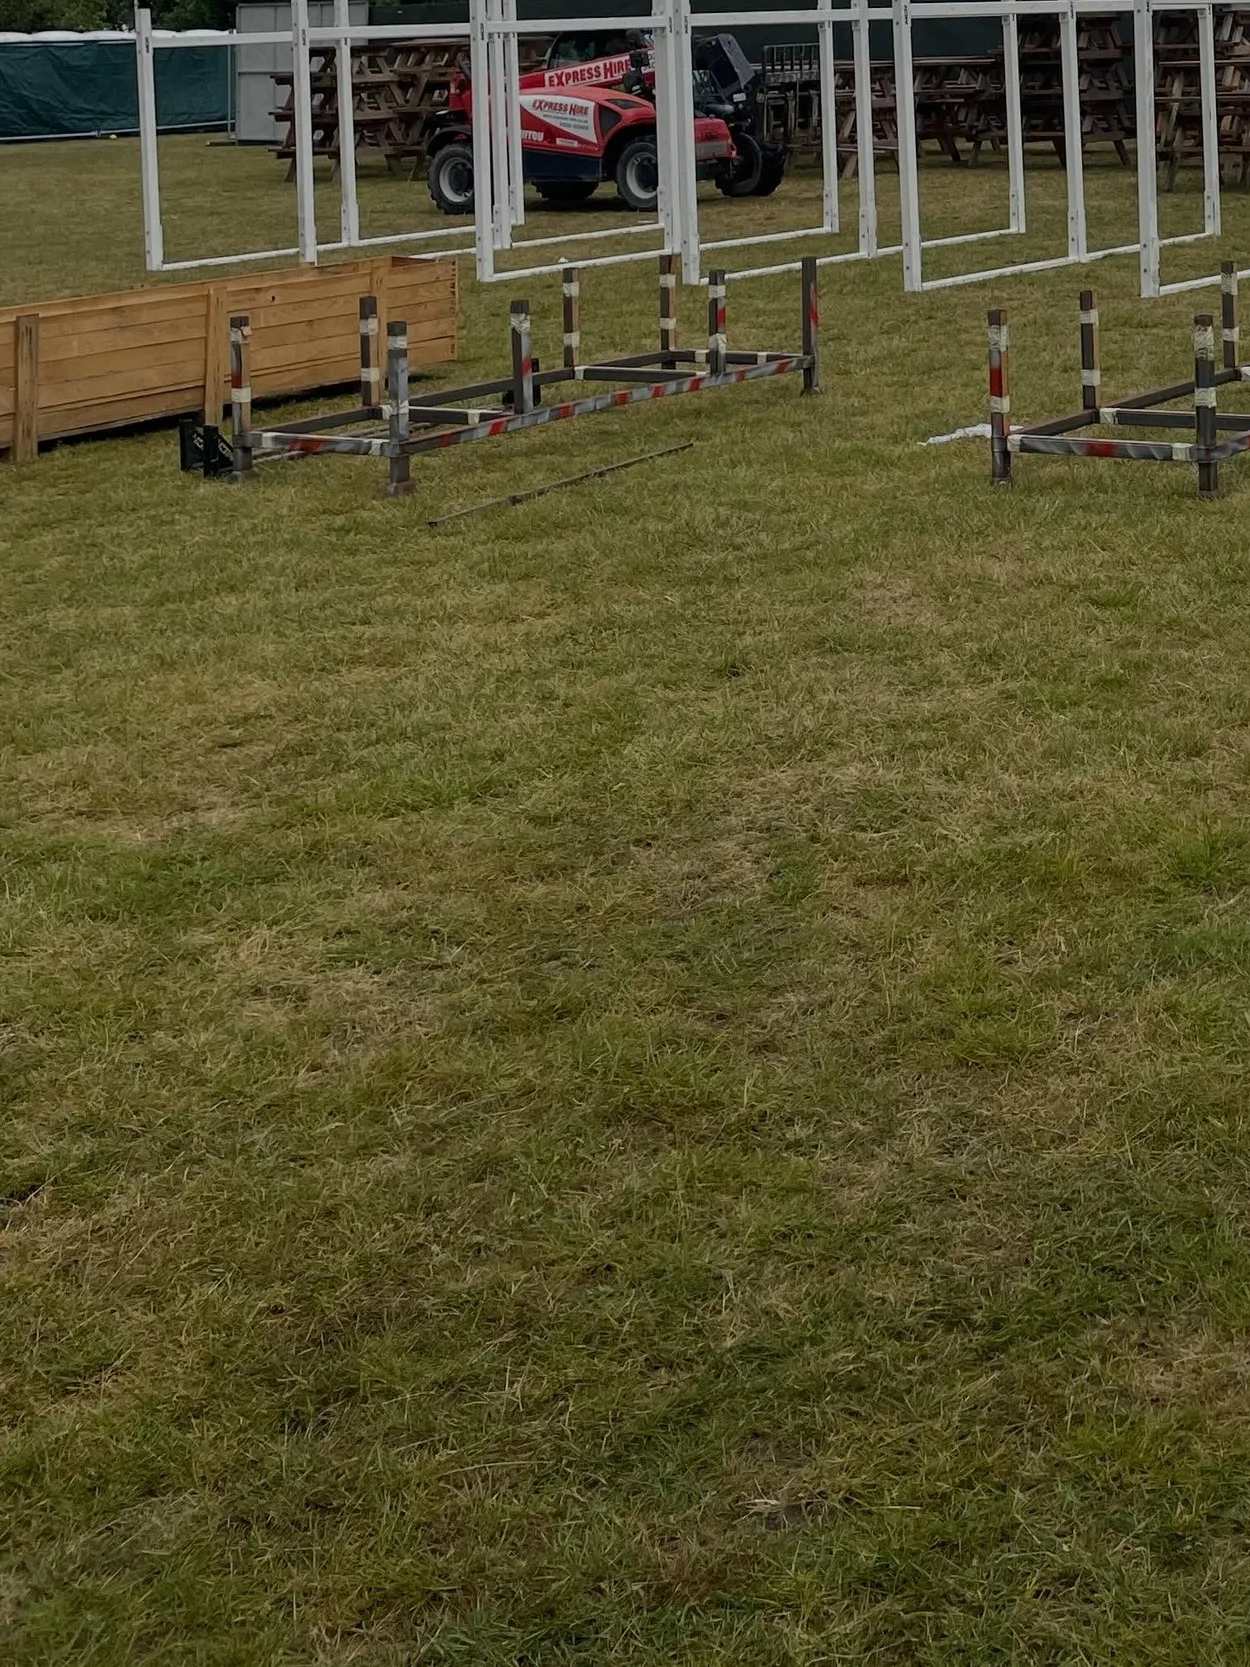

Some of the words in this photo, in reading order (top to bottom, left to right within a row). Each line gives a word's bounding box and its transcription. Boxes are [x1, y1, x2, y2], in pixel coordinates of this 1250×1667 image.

[548, 65, 601, 86] EXPRESS
[603, 60, 631, 79] HIRE
[532, 99, 568, 111] EXPRESS
[568, 103, 589, 115] HIRE
